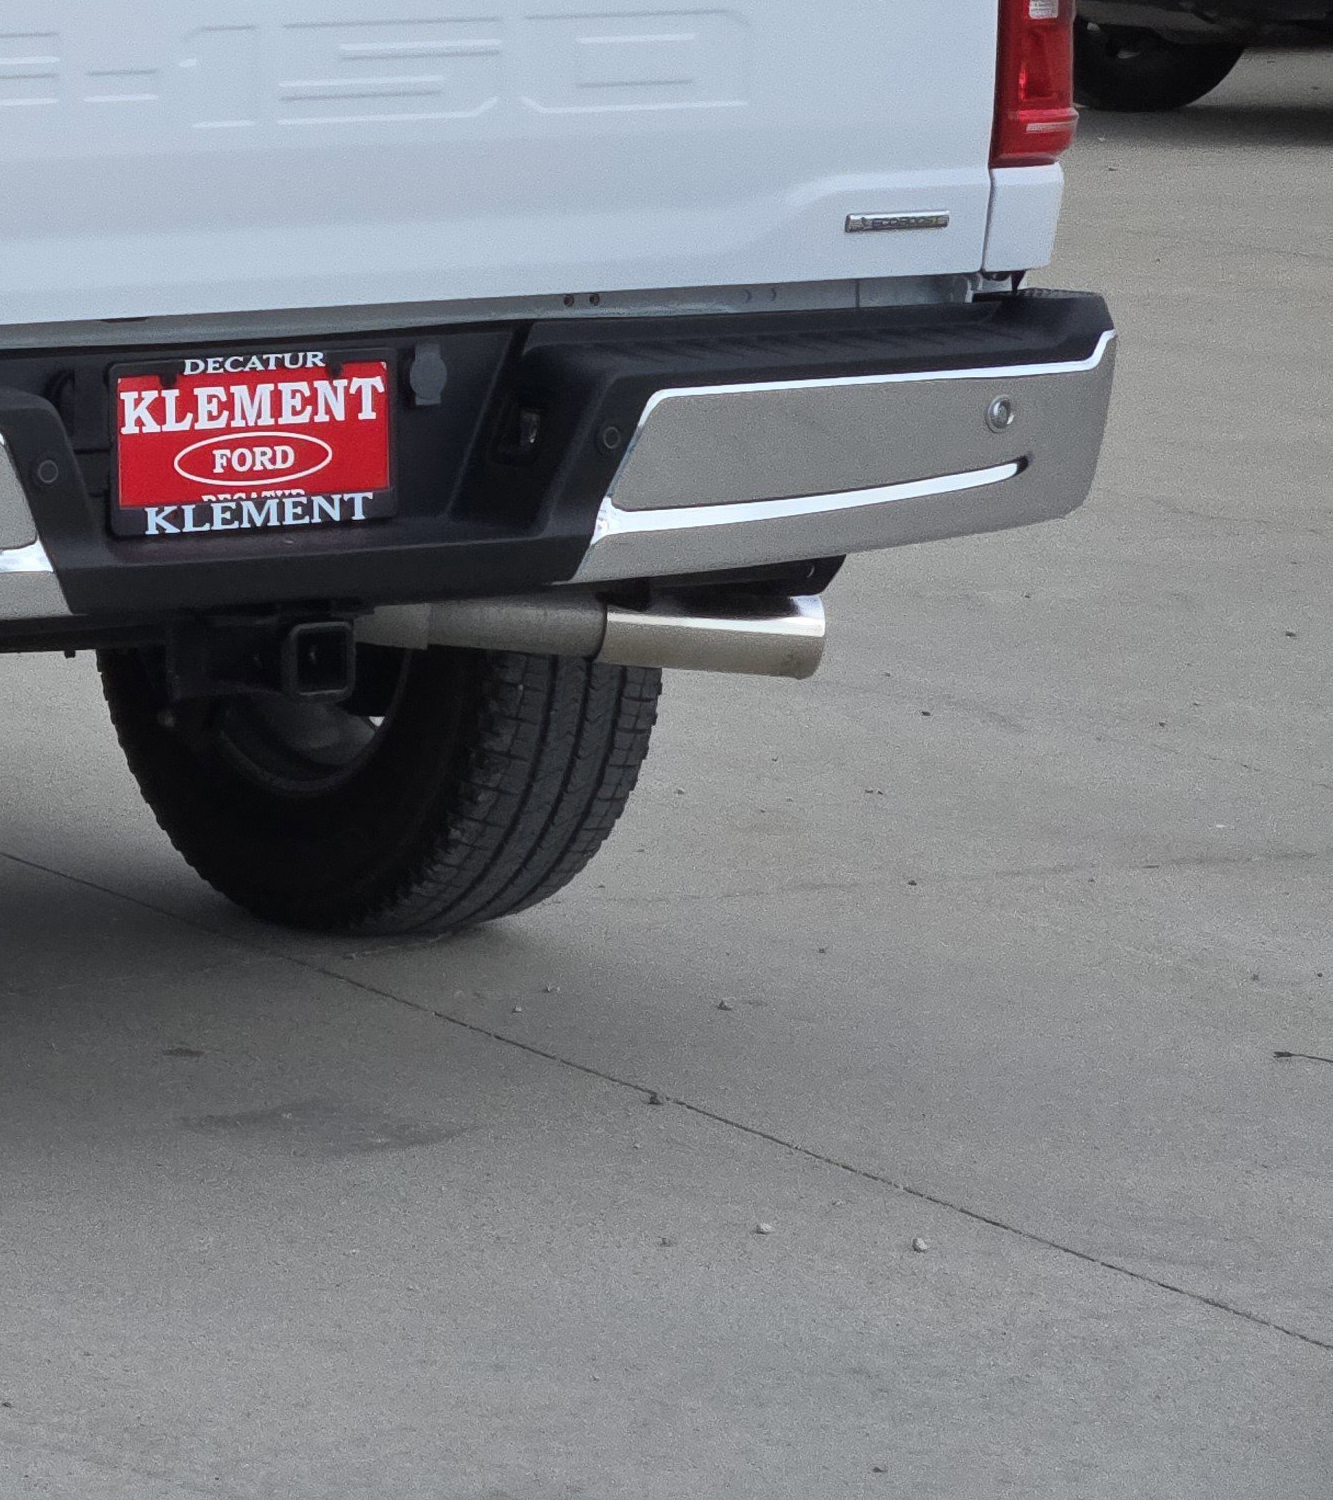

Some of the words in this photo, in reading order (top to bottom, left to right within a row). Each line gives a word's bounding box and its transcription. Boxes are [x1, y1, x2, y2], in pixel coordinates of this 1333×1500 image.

[183, 351, 326, 376] DECATUR
[120, 376, 385, 435] KLEMENT
[212, 445, 296, 474] FORD
[144, 492, 374, 536] KLEMENT
